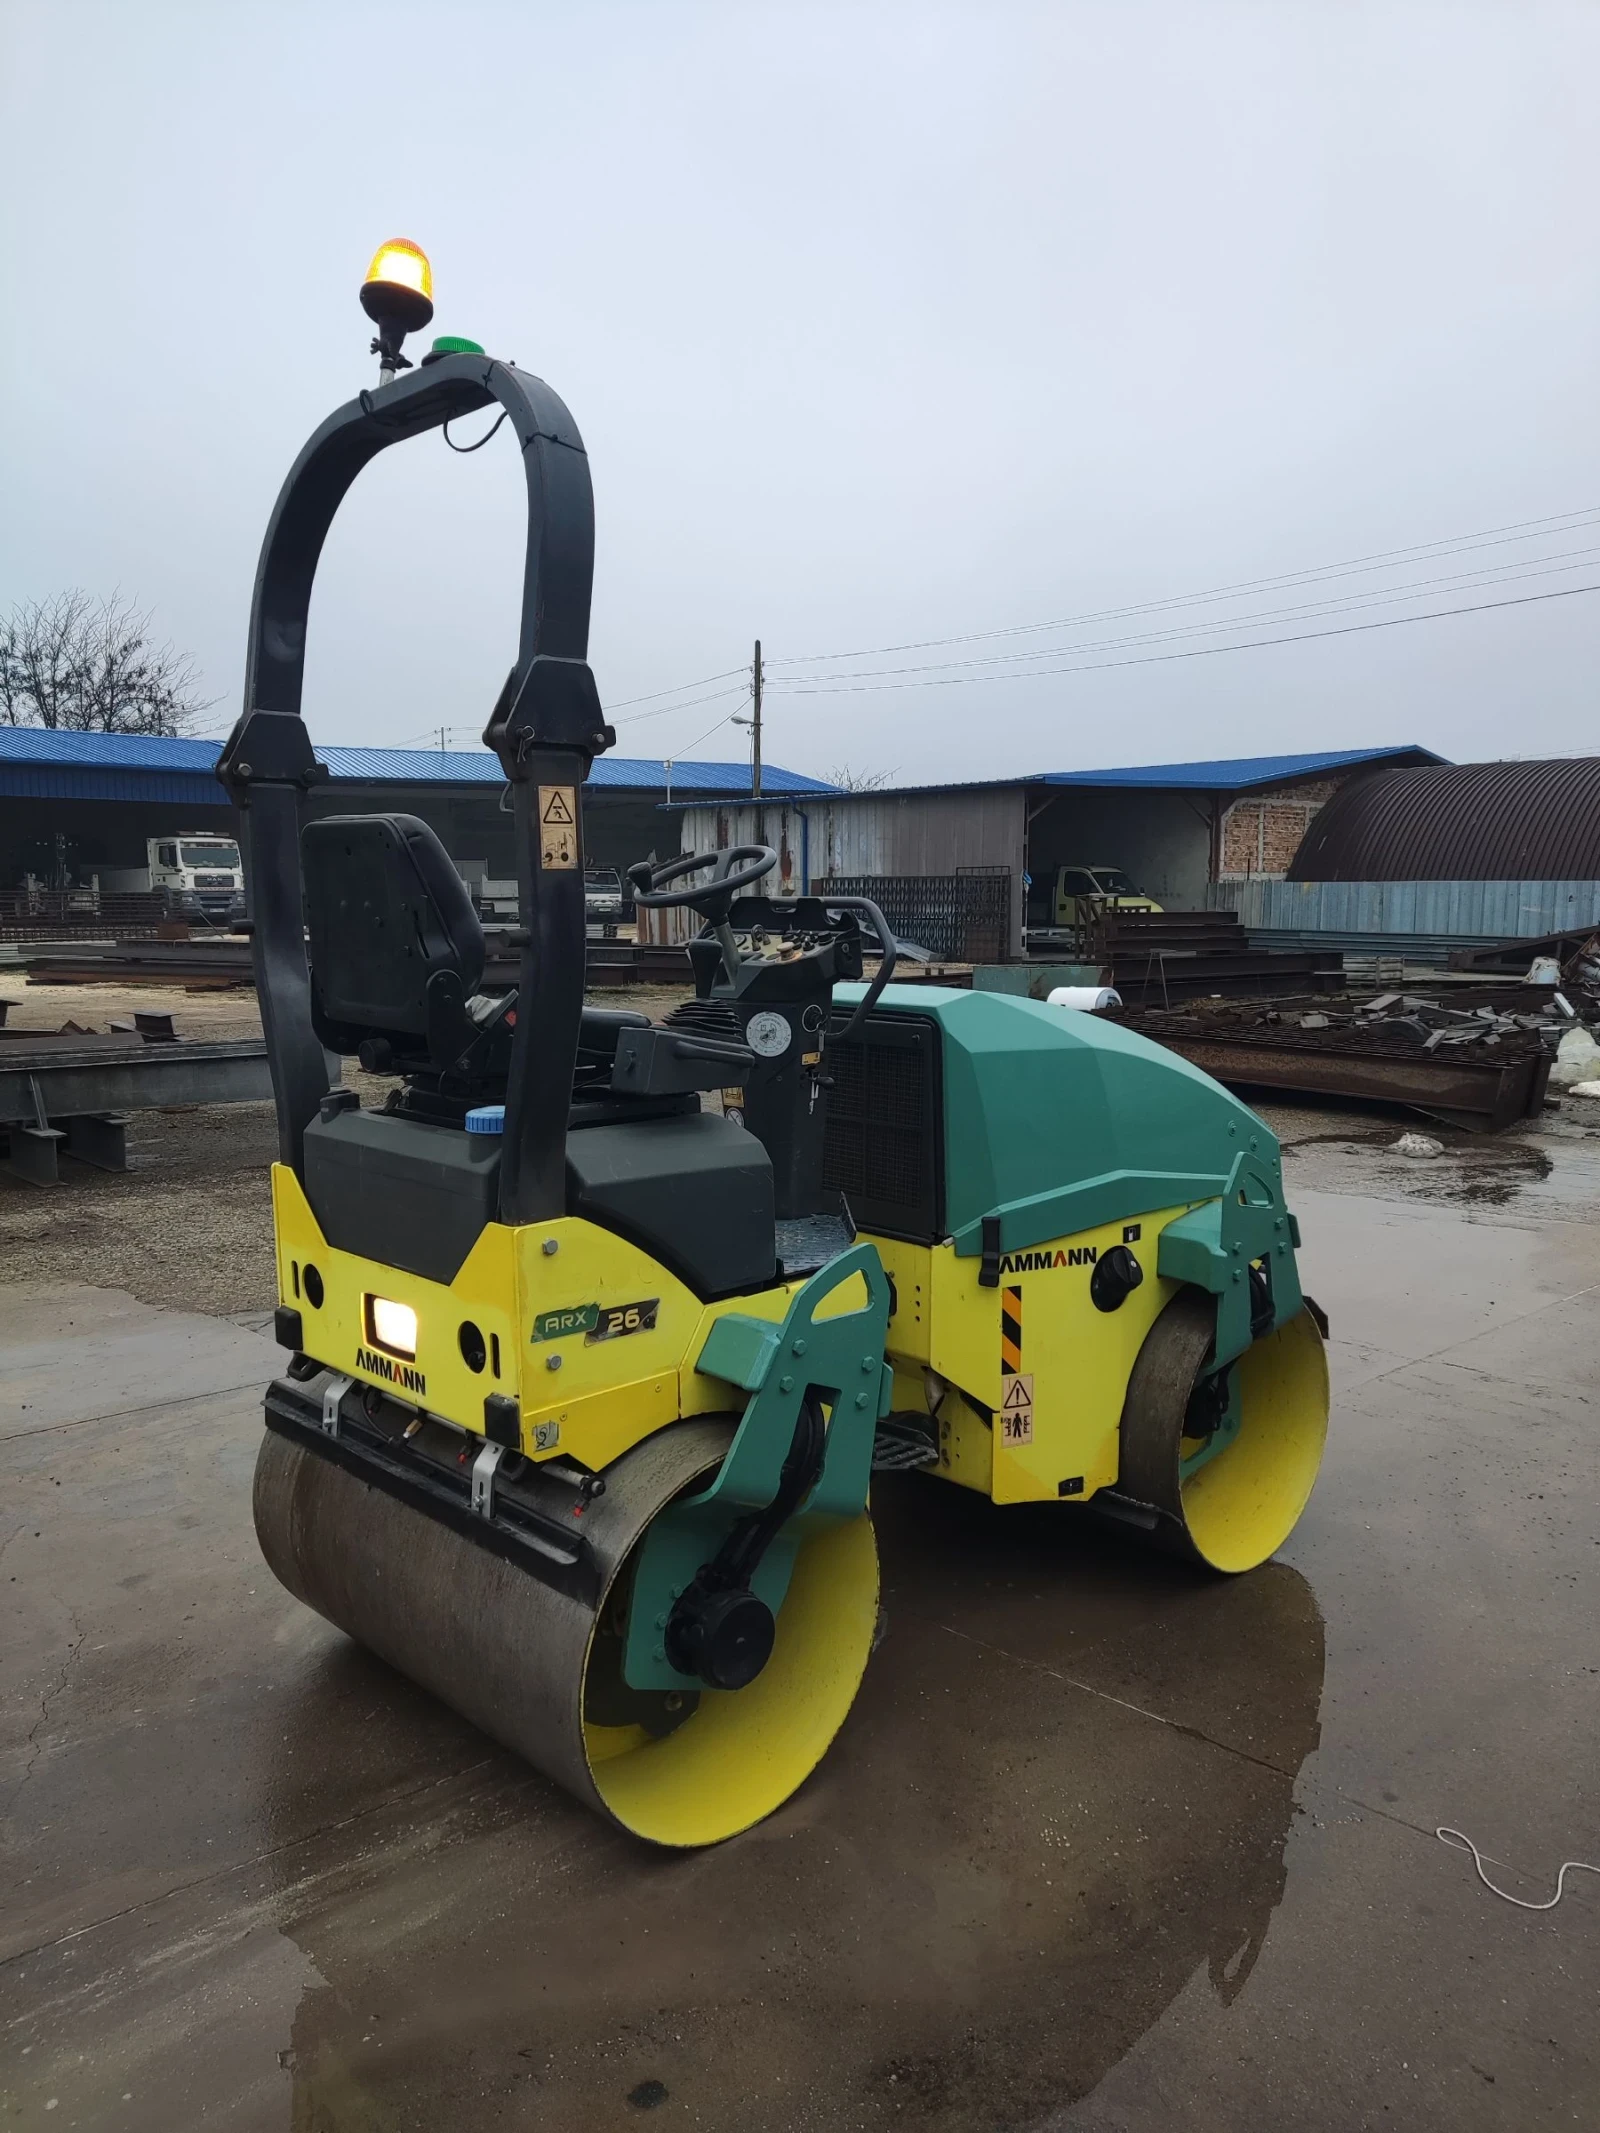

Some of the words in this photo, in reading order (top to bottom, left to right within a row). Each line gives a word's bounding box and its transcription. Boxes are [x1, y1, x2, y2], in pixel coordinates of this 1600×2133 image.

[999, 1247, 1097, 1274] AMMANN
[544, 1310, 587, 1333] ARX
[607, 1307, 640, 1333] 26
[355, 1347, 426, 1396] AMMANN
